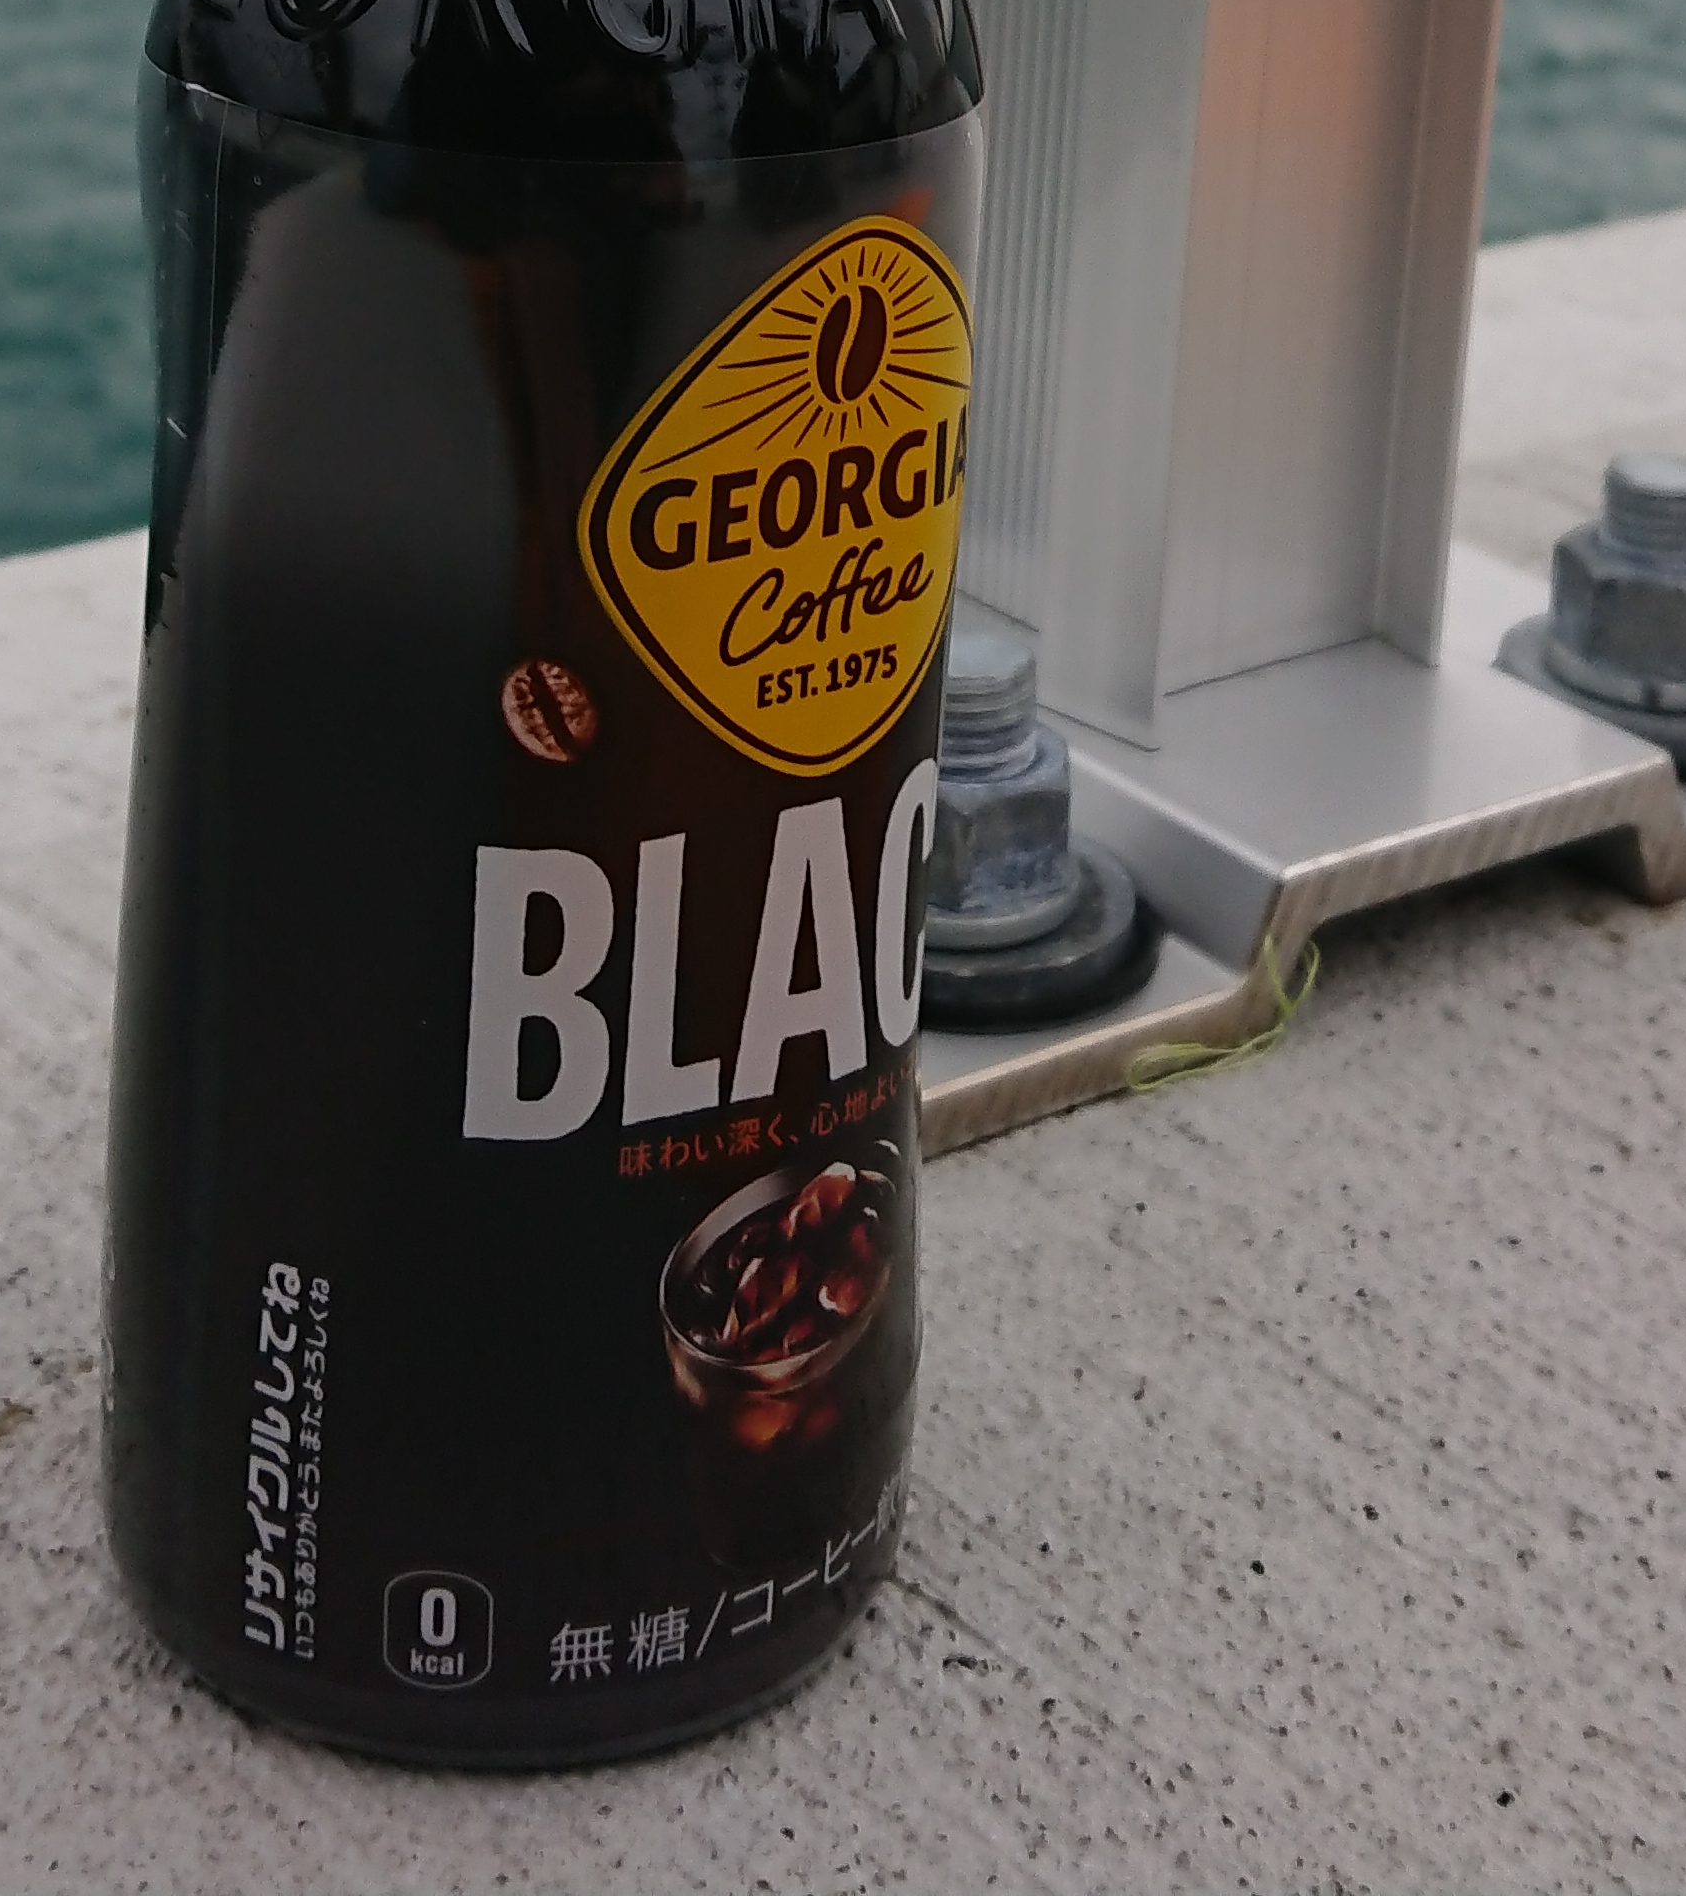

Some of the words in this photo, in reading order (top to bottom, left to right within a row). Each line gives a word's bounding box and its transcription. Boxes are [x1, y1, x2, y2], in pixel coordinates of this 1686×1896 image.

[719, 537, 935, 667] Coffee
[756, 662, 820, 709] EST.
[825, 643, 899, 693] 1975
[243, 1260, 303, 1651] リサイクルしてね
[293, 1277, 332, 1661] いつもありがとう、またよろしくね
[409, 1647, 466, 1677] kcal
[419, 1586, 458, 1648] 0
